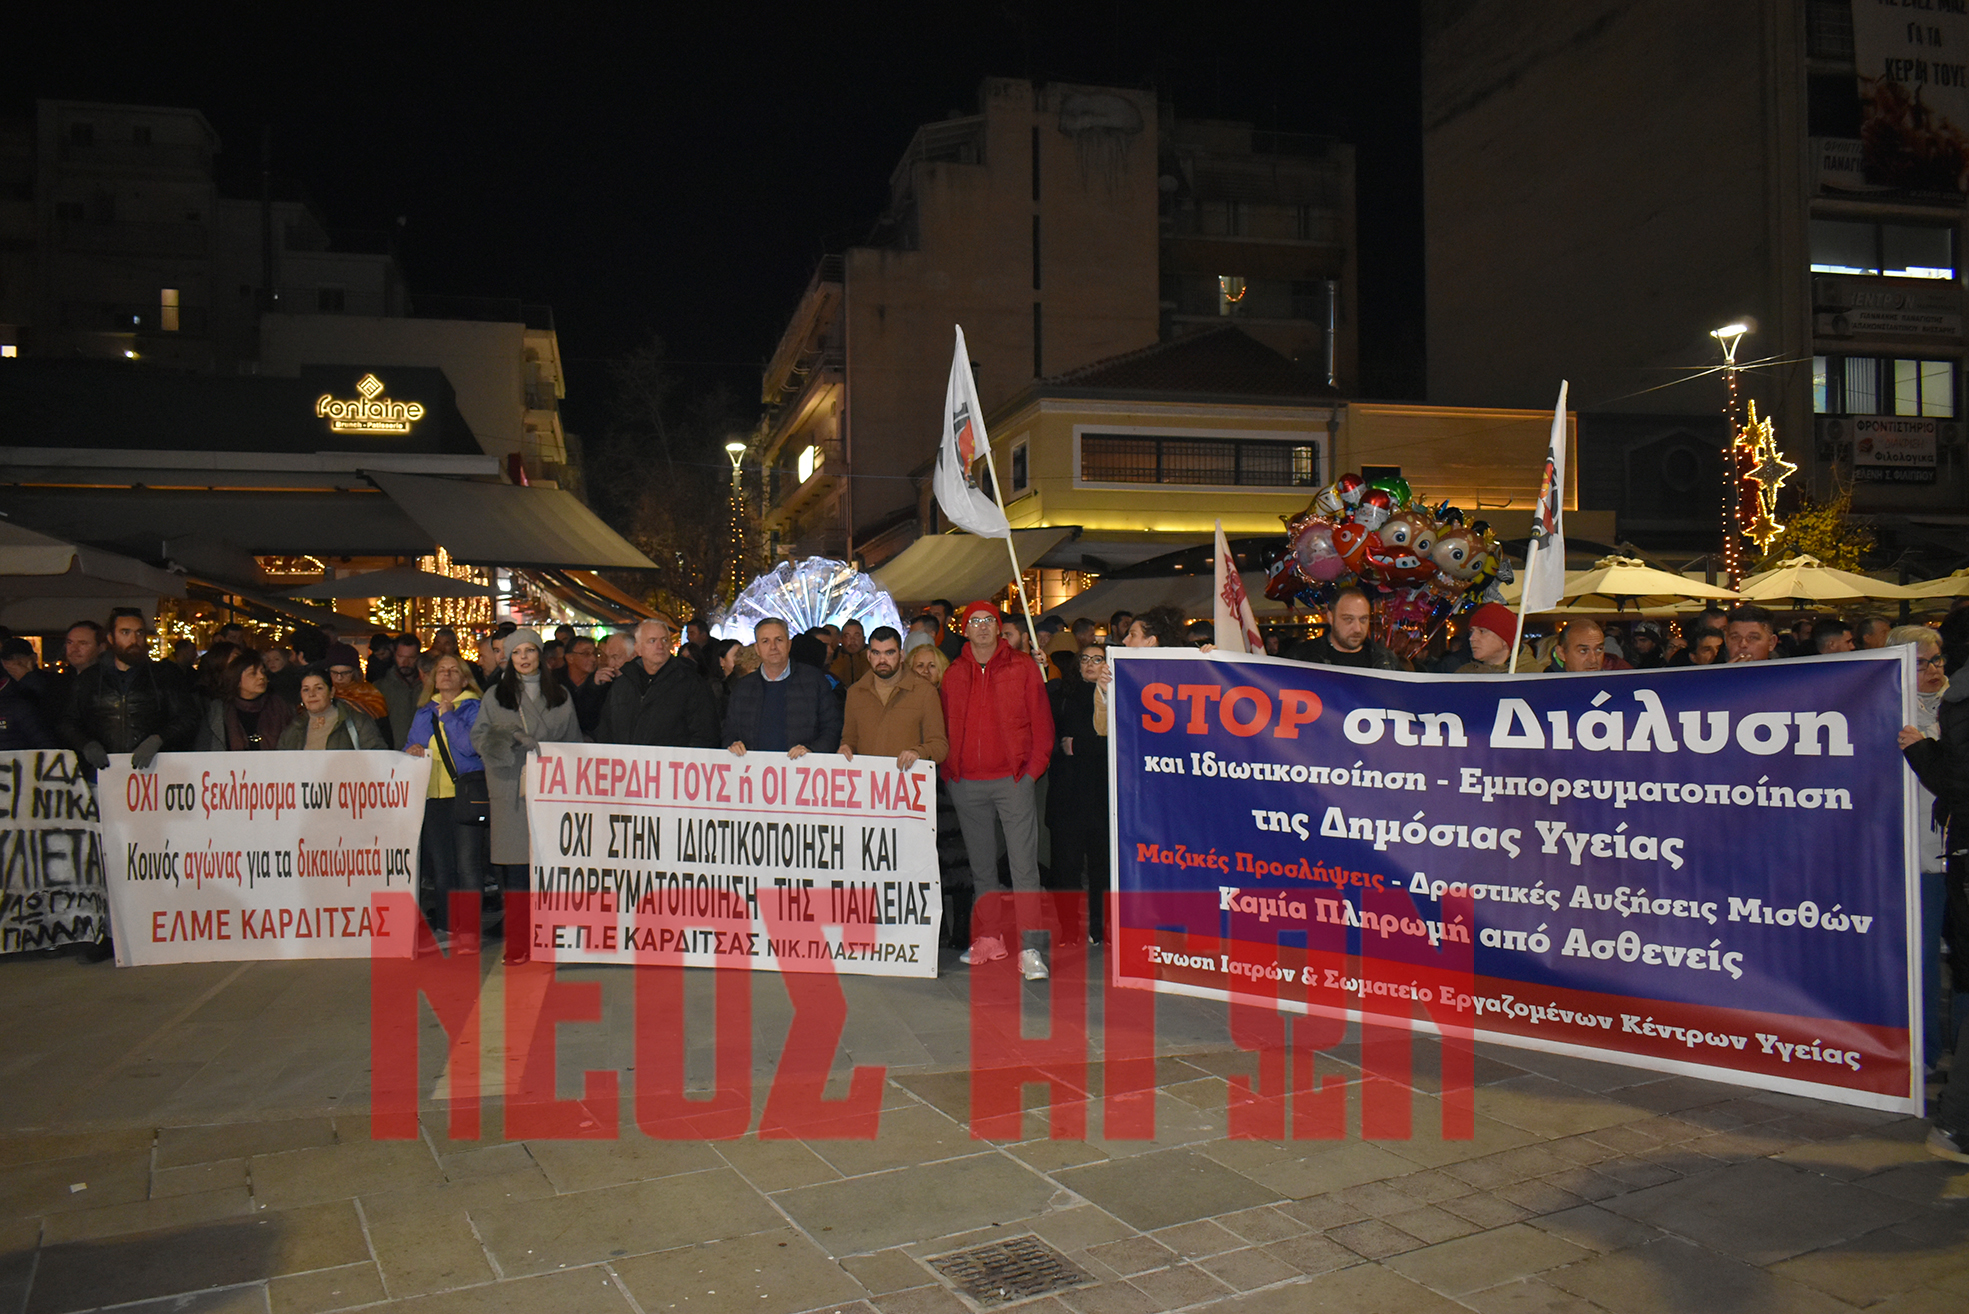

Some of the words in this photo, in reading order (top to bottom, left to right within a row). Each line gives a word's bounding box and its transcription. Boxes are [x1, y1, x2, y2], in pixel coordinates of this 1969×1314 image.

[1857, 420, 1935, 434] ΦΡΟΝΤΙΣΤΗΡΙΟ
[1140, 682, 1323, 739] STOP
[1342, 707, 1468, 748] στη
[1489, 688, 1855, 757] Διάλυση
[32, 786, 101, 823] ΝΙΚΑ
[127, 772, 158, 812] ΟΧΙ
[165, 783, 195, 811] στο
[201, 768, 296, 820] ξεκλήρισμα
[301, 783, 333, 810] των
[337, 768, 410, 820] αγροτών
[536, 755, 568, 795] ΤΑ
[576, 757, 661, 799] ΚΕΡΔΗ
[668, 761, 731, 803] ΤΟΥΣ
[739, 764, 754, 805] ή
[761, 766, 787, 806] ΟΙ
[795, 767, 862, 809] ΖΩΕΣ
[870, 770, 927, 813] ΜΑΣ
[1144, 754, 1185, 775] και
[1190, 751, 1427, 791] Ιδιωτικοποίηση
[1459, 766, 1853, 810] Εμπορευματοποίηση
[127, 838, 179, 887] Κοινός
[184, 838, 242, 889] αγώνας
[247, 851, 271, 888] για
[275, 853, 292, 879] τα
[297, 836, 382, 888] δικαιώματά
[385, 846, 412, 887] μας
[559, 811, 592, 857] ΟΧΙ
[608, 813, 661, 860] ΣΤΗΝ
[677, 817, 845, 871] ΙΔΙΩΤΙΚΟΠΟΙΗΣΗ
[861, 826, 898, 872] ΚΑΙ
[1251, 808, 1309, 841] της
[1320, 806, 1522, 860] Δημόσιας
[1534, 820, 1685, 870] Υγείας
[534, 866, 759, 921] ΜΠΟΡΕΥΜΑΤΟΠΟΙΗΣΗ
[774, 877, 815, 923] ΤΗΣ
[832, 880, 932, 926] ΠΑΙΔΕΙΑΣ
[1136, 843, 1230, 874] Μαζικές
[1235, 852, 1385, 894] Προσλήψεις
[1409, 871, 1561, 911] Δραστικές
[1568, 884, 1717, 925] Αυξήσεις
[1727, 896, 1873, 934] Μισθών
[152, 909, 231, 943] ΕΛΜΕ
[242, 906, 391, 939] ΚΑΡΔΙΤΣΑΣ
[624, 927, 760, 957] ΚΑΡΔΙΤΣΑΣ
[1218, 886, 1308, 923] Καμία
[1314, 897, 1471, 946] Πληρωμή
[1479, 922, 1551, 954] από
[1561, 927, 1744, 979] Ασθενείς
[1142, 944, 1215, 972] Ένωση
[1220, 954, 1295, 983] Ιατρών
[1301, 966, 1318, 986] &
[1323, 969, 1433, 1001] Σωματείο
[1439, 985, 1613, 1030] Εργαζομένων
[1620, 1012, 1748, 1050] Κέντρων
[1755, 1032, 1862, 1071] Υγείας
